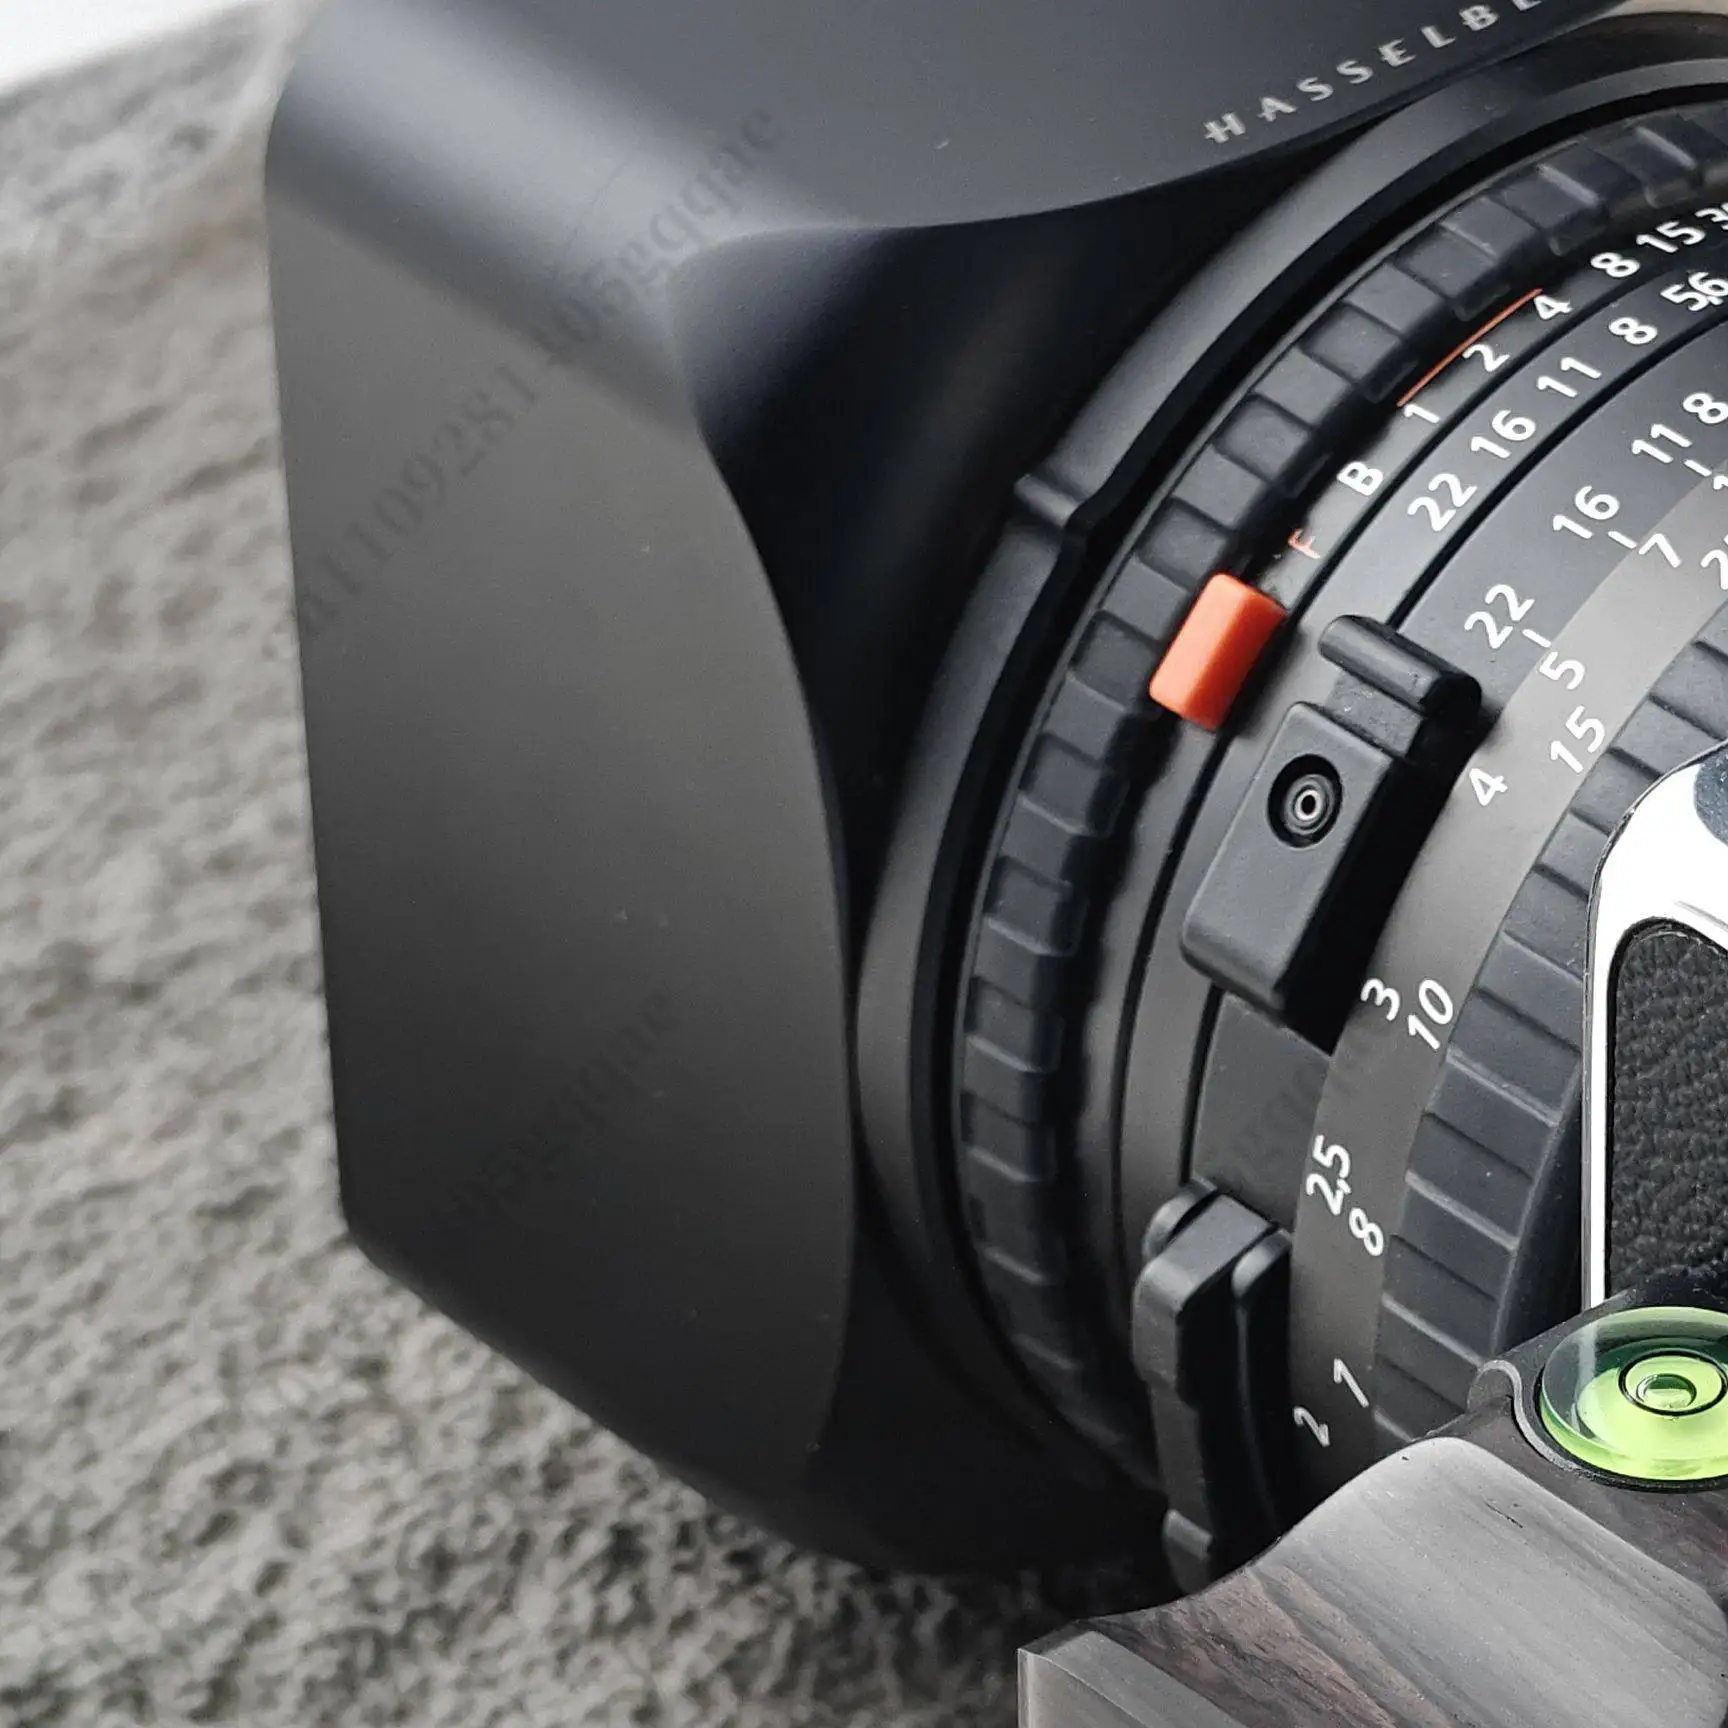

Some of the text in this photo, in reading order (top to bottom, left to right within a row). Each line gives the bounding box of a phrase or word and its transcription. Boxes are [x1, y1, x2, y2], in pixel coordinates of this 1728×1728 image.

[1337, 461, 1384, 496] B
[1403, 403, 1440, 424] 1
[1461, 343, 1511, 372] 2
[1533, 294, 1573, 320] 4
[1590, 251, 1641, 279] 8
[1635, 221, 1706, 253] 15
[1407, 472, 1478, 532] 22
[1470, 410, 1536, 459] 16
[1536, 357, 1601, 398] 11
[1608, 316, 1658, 345] 8
[1464, 584, 1535, 650] 22
[1553, 485, 1621, 539] 16
[1631, 423, 1693, 464] 11
[1360, 978, 1400, 1021] 3
[1468, 767, 1508, 806] 4
[1539, 651, 1586, 690] 5
[1638, 533, 1682, 568] 7
[1349, 1206, 1385, 1257] 8
[1407, 979, 1453, 1050] 10
[1550, 705, 1605, 774] 15
